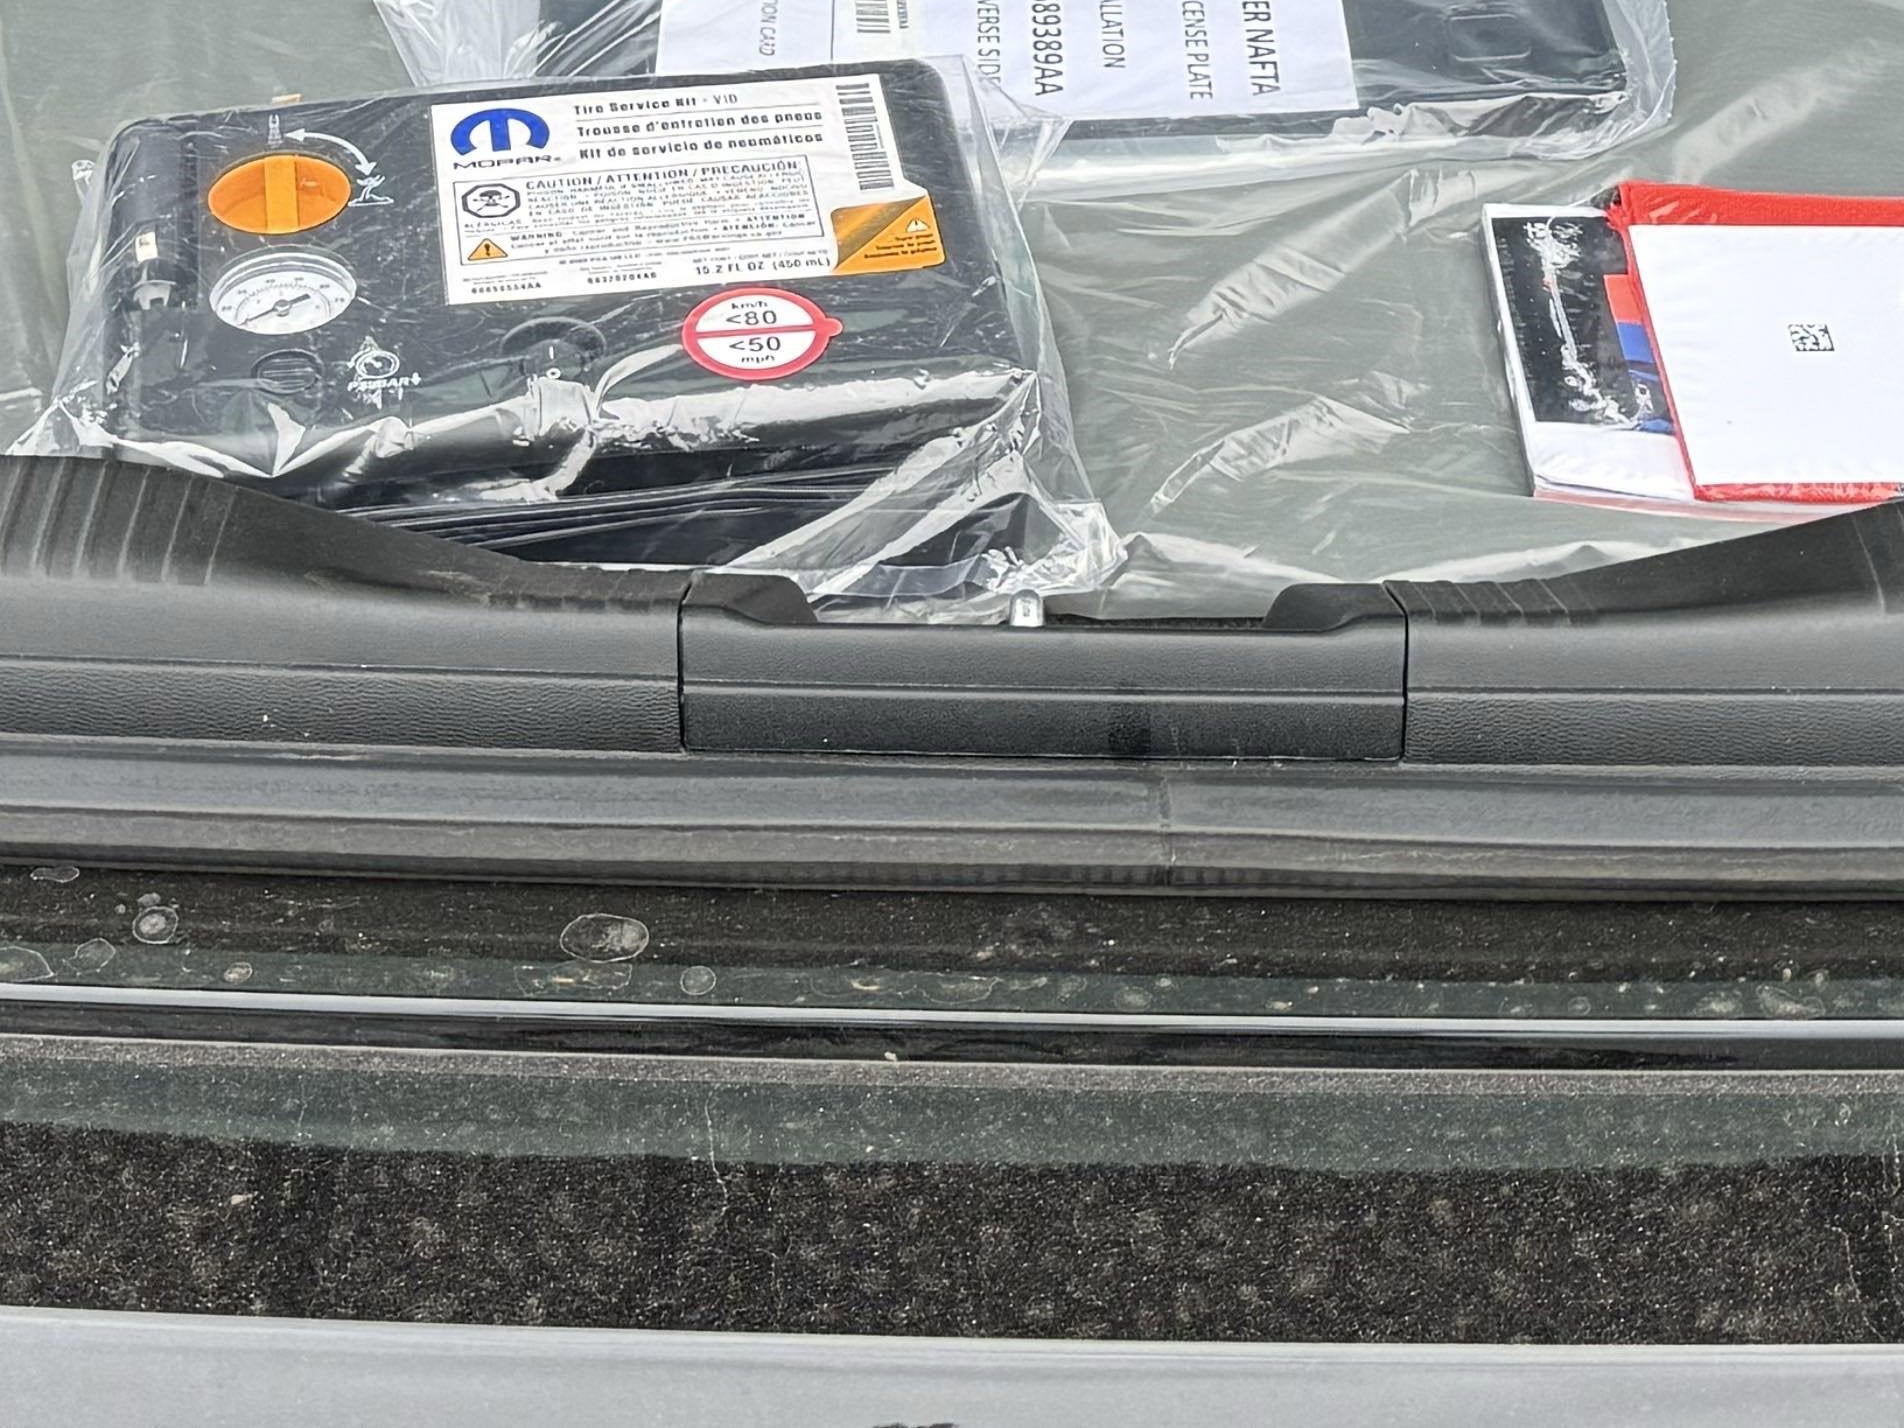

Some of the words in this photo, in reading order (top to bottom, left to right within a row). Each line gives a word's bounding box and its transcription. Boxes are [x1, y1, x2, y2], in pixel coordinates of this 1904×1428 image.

[1187, 52, 1214, 100] PLATE
[1246, 28, 1282, 96] NAFTA
[574, 104, 604, 116] Tire
[609, 98, 670, 113] Service
[675, 96, 697, 107] Kit
[577, 123, 640, 138] Trousse
[645, 117, 736, 132] d'entretien
[741, 113, 769, 125] des
[775, 110, 823, 124] pneus
[579, 148, 602, 160] Kit
[607, 145, 626, 157] de
[632, 140, 698, 156] servicio
[703, 138, 723, 150] de
[728, 132, 823, 148] neumáticos
[525, 176, 593, 191] CAUTION
[606, 167, 689, 185] ATTENTION
